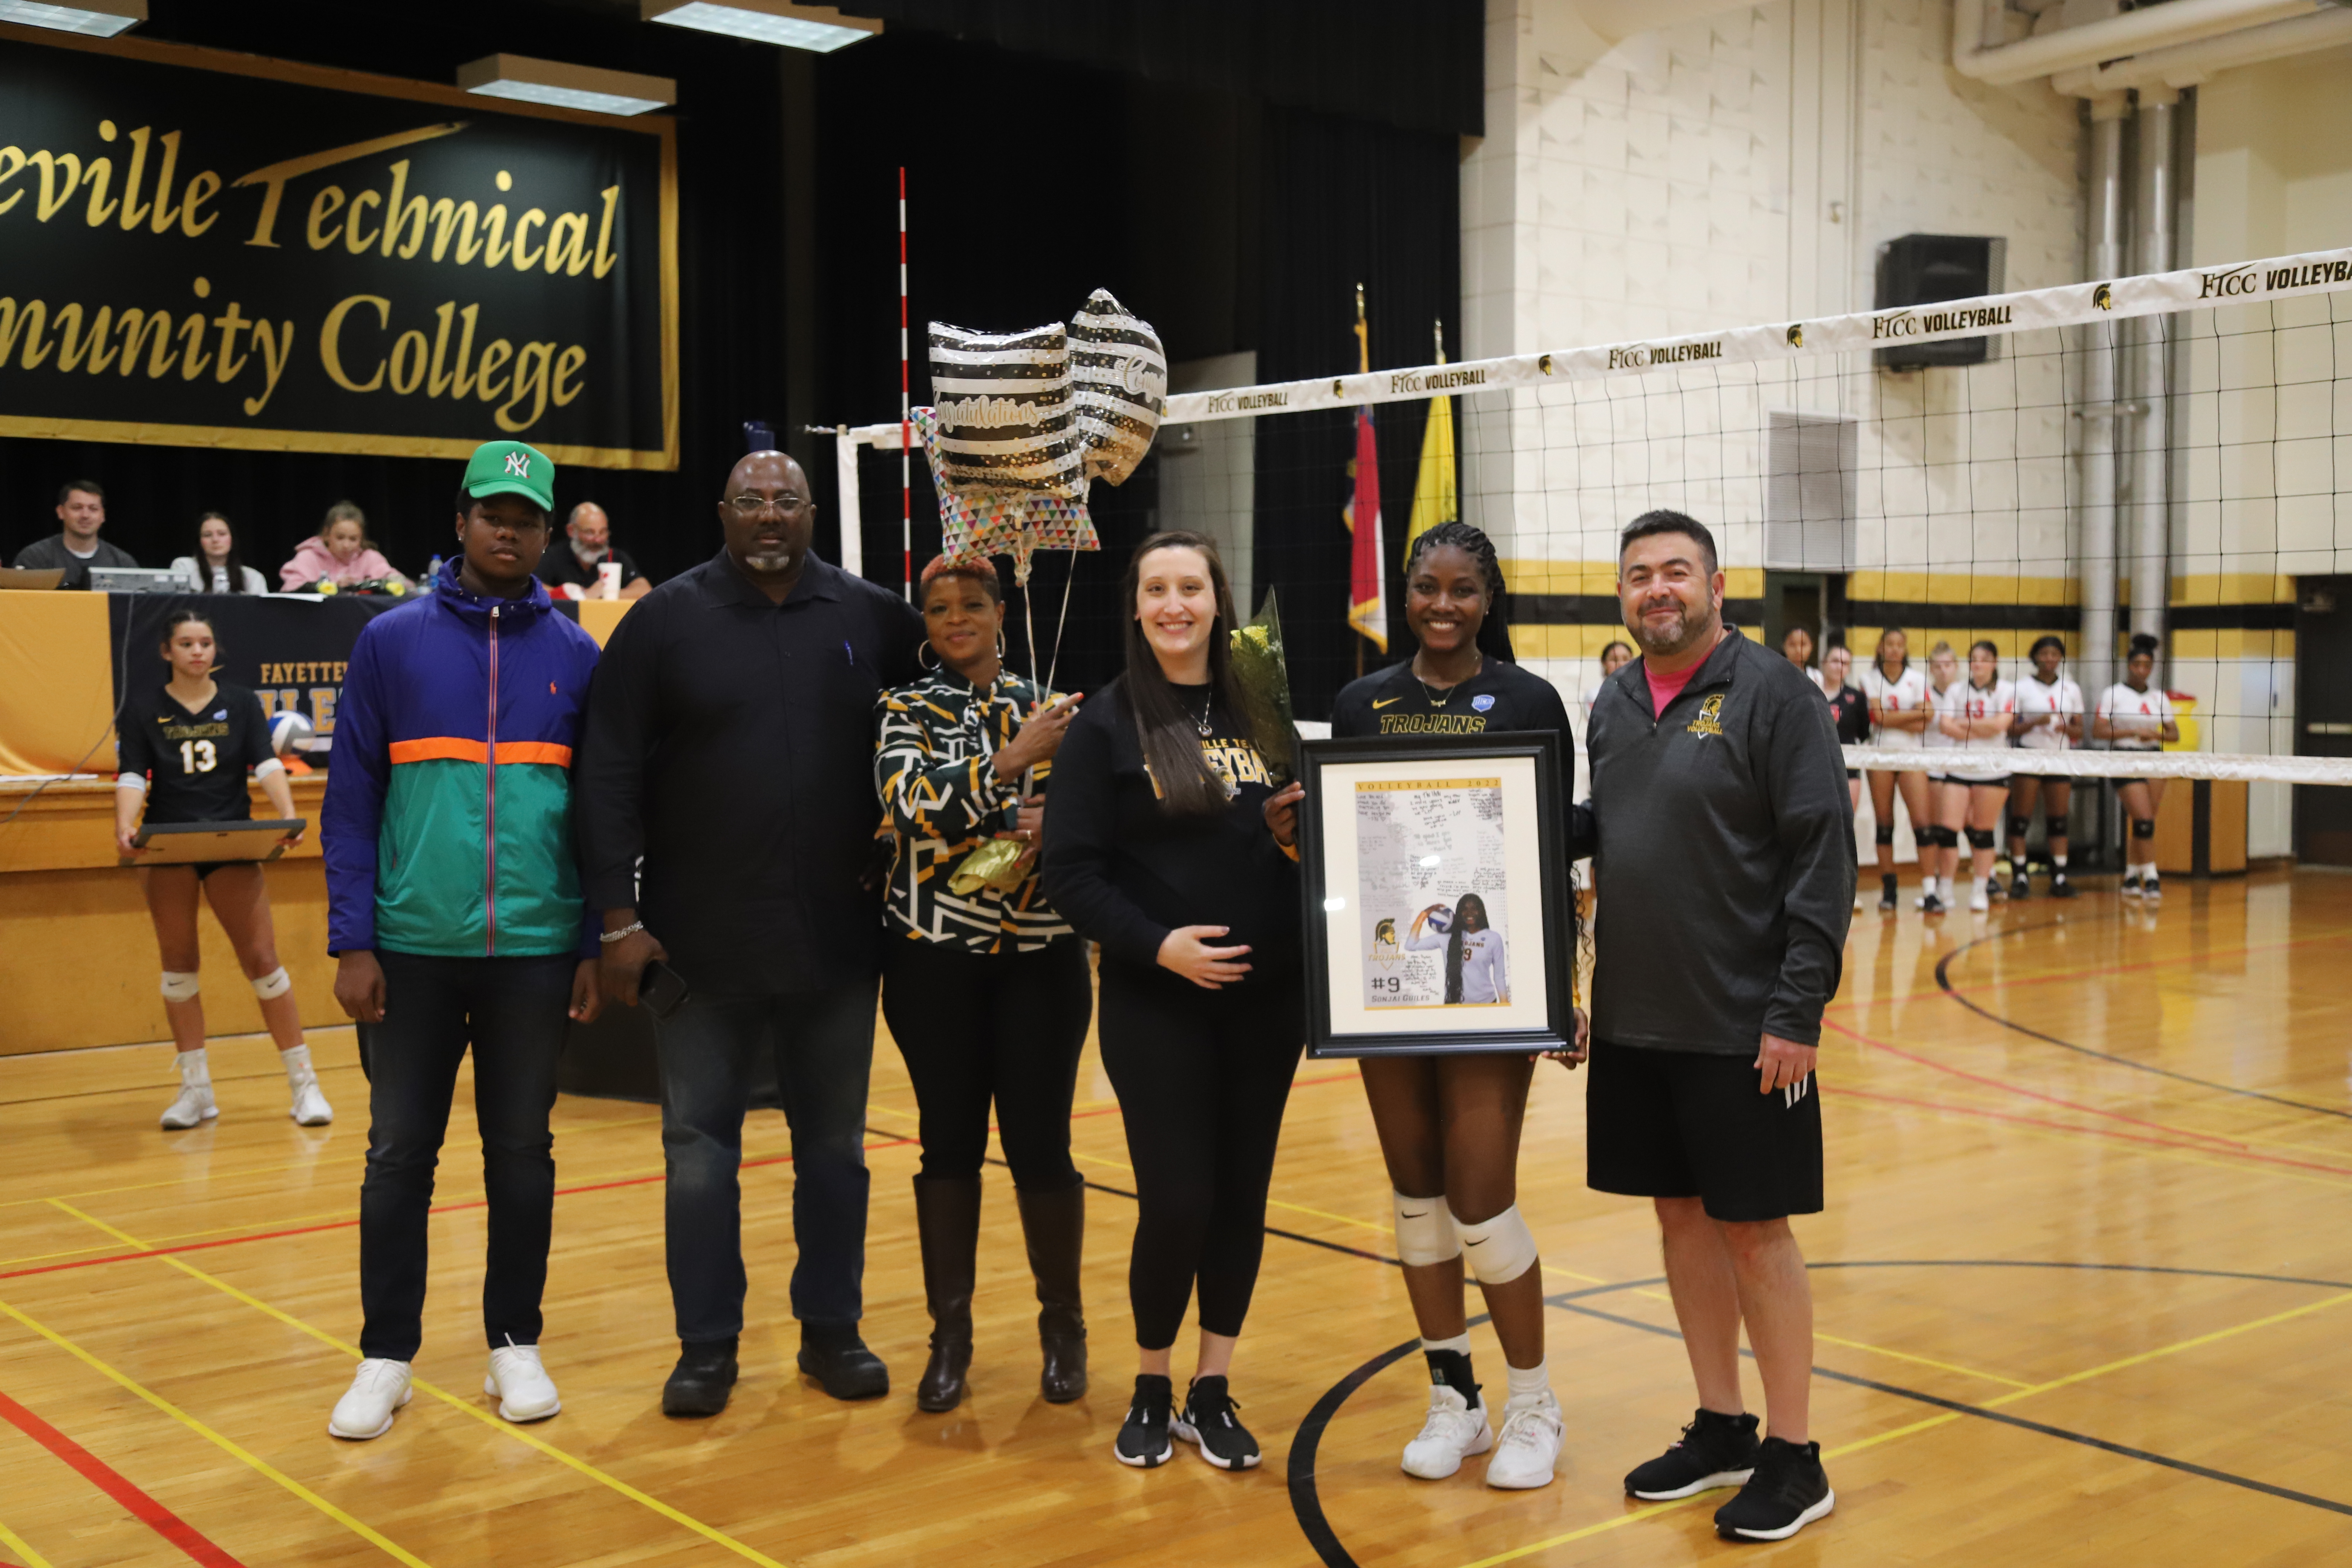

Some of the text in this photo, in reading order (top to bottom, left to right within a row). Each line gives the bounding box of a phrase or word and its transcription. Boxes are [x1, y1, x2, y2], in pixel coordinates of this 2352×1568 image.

[232, 121, 619, 279] Technical
[2197, 262, 2257, 299] FTCC
[1872, 305, 2012, 339] FTCC VOLLEYBALL
[320, 295, 586, 432] College
[1608, 341, 1722, 369] FTCC VOLLEYBALL
[1391, 369, 1485, 393] FTCC VOLLEYBALL
[1208, 391, 1288, 413] FTCC VOLLEYBALL
[504, 451, 531, 479] NY
[1380, 714, 1487, 734] TROJANS
[1687, 725, 1723, 735] VOLLEYBALL
[1692, 720, 1720, 728] TROJANS
[1232, 738, 1253, 749] TE
[180, 740, 218, 774] 13
[1358, 781, 1451, 790] VOLLEYBALL
[1463, 948, 1472, 961] 9
[1371, 977, 1400, 993] #9
